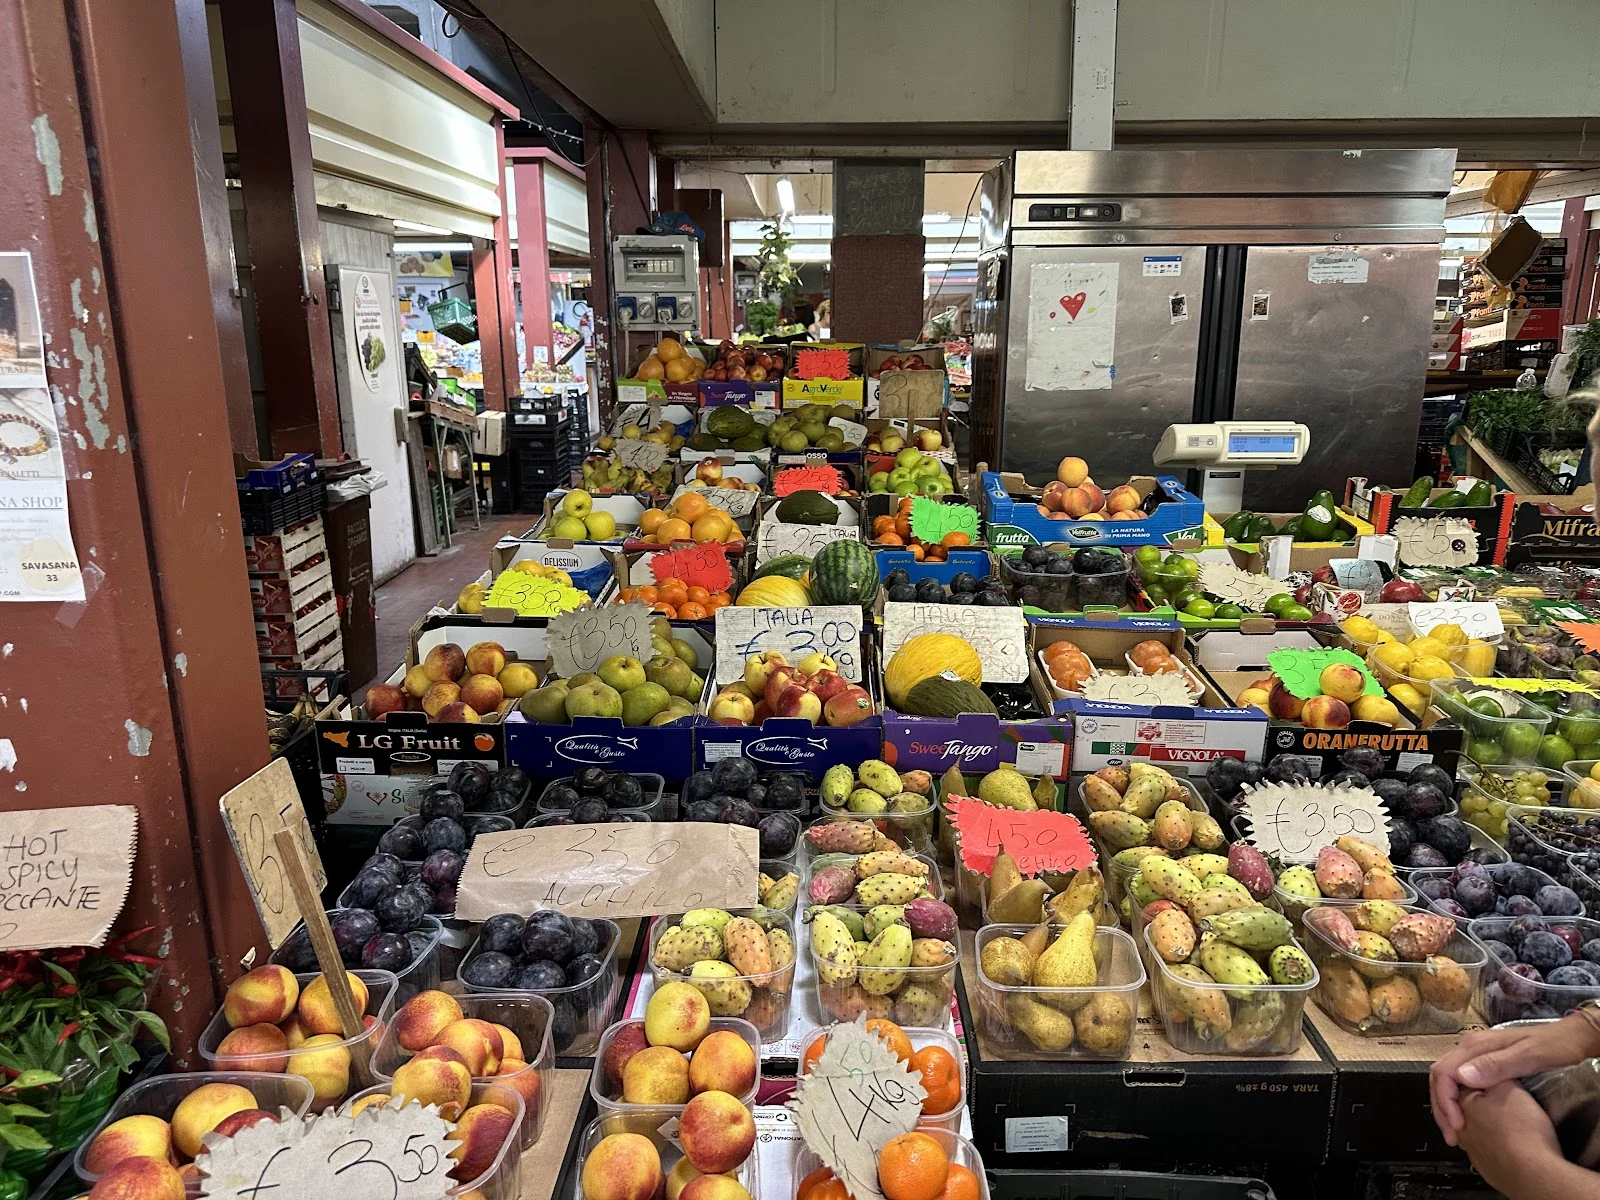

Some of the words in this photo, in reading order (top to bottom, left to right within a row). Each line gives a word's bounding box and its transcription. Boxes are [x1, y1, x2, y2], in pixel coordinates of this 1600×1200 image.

[802, 384, 842, 395] AgroVerde
[22, 496, 63, 508] SHOP
[996, 532, 1030, 544] frutta
[21, 561, 78, 570] SAVASANA
[544, 556, 580, 568] DELISSIUM
[46, 574, 59, 582] 33
[357, 734, 393, 749] LG
[400, 736, 461, 750] Fruit
[564, 740, 600, 750] Qualità
[755, 742, 790, 752] Qualità
[599, 746, 626, 759] Gusto
[789, 747, 815, 760] Gusto
[1168, 750, 1222, 760] VIGNOLA
[3, 829, 68, 862] HOT
[1, 857, 79, 891] SPICY
[1260, 1083, 1268, 1091] g
[1269, 1084, 1288, 1092] 450
[1292, 1084, 1320, 1092] TARA
